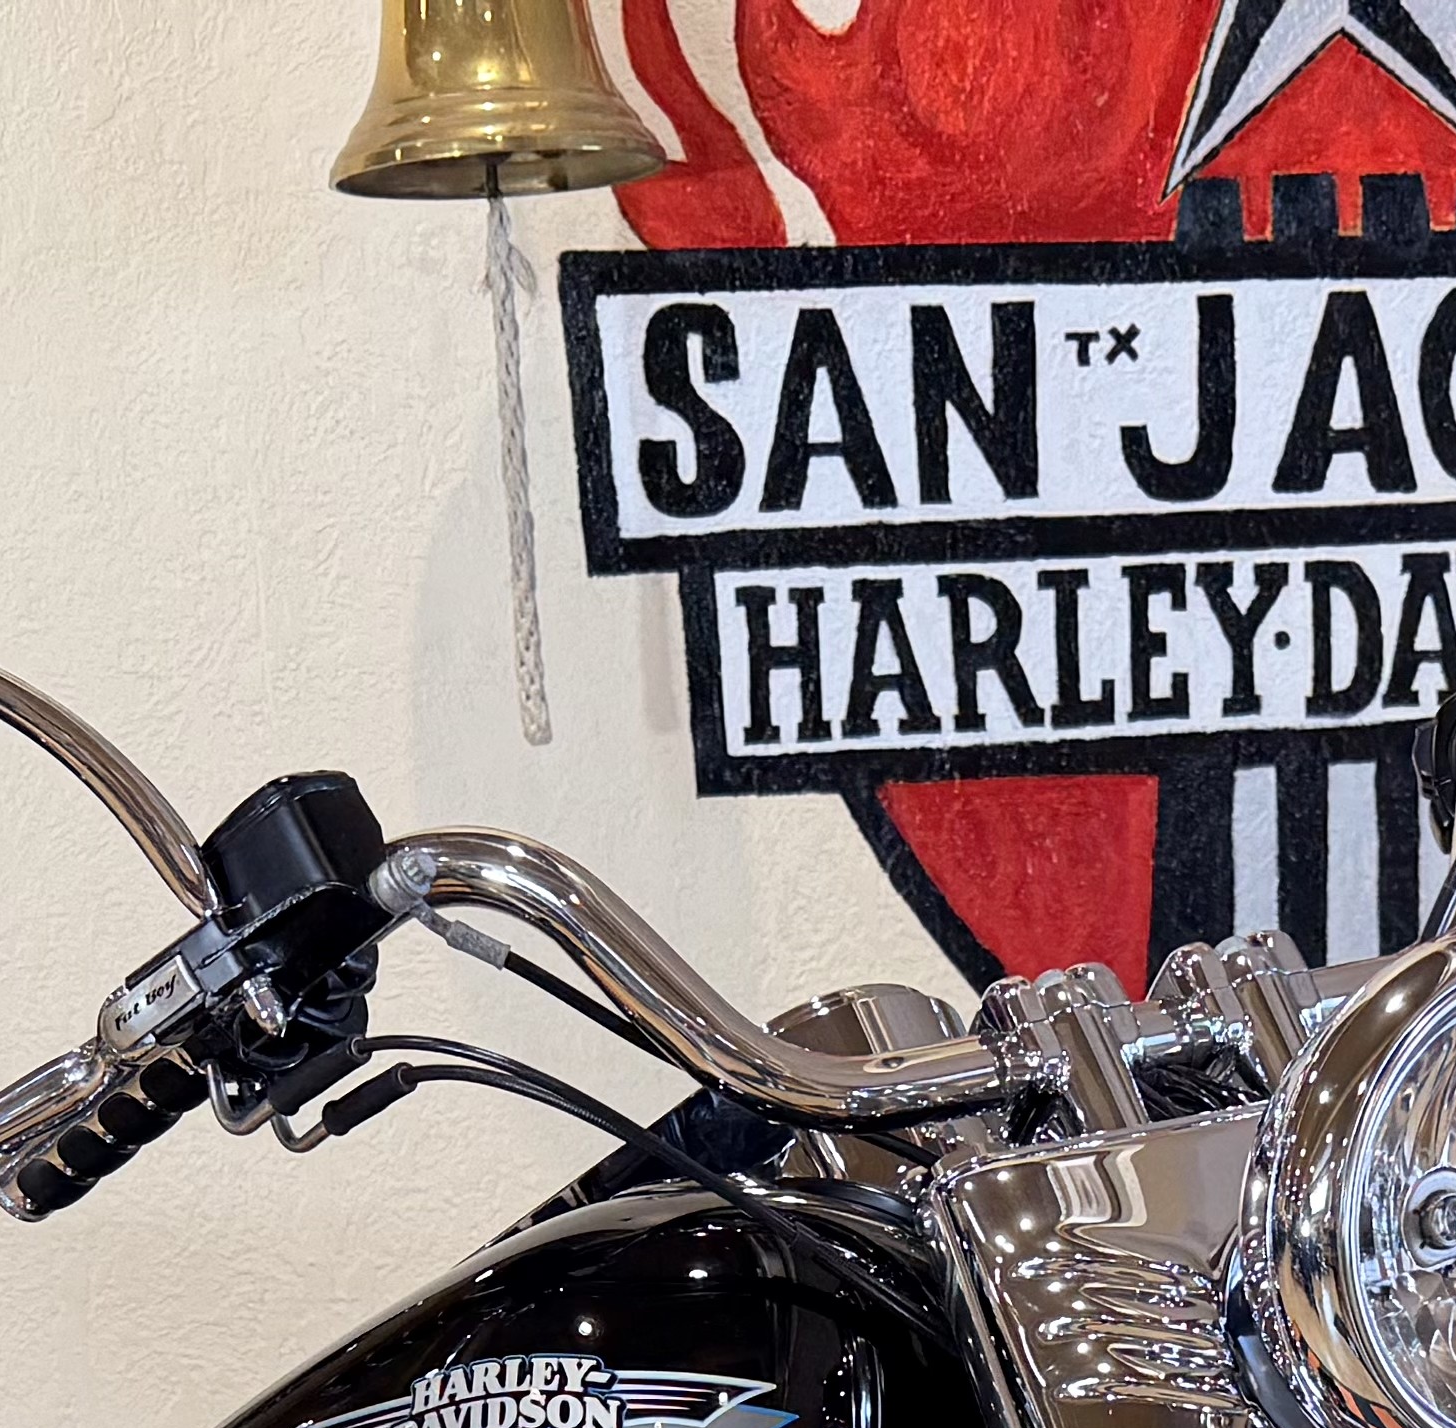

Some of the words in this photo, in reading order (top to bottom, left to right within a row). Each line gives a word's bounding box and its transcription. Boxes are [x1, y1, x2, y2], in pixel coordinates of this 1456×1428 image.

[1067, 325, 1140, 368] TX
[638, 302, 1039, 517] SAN
[115, 1003, 140, 1031] Fat
[145, 974, 176, 1006] Boy
